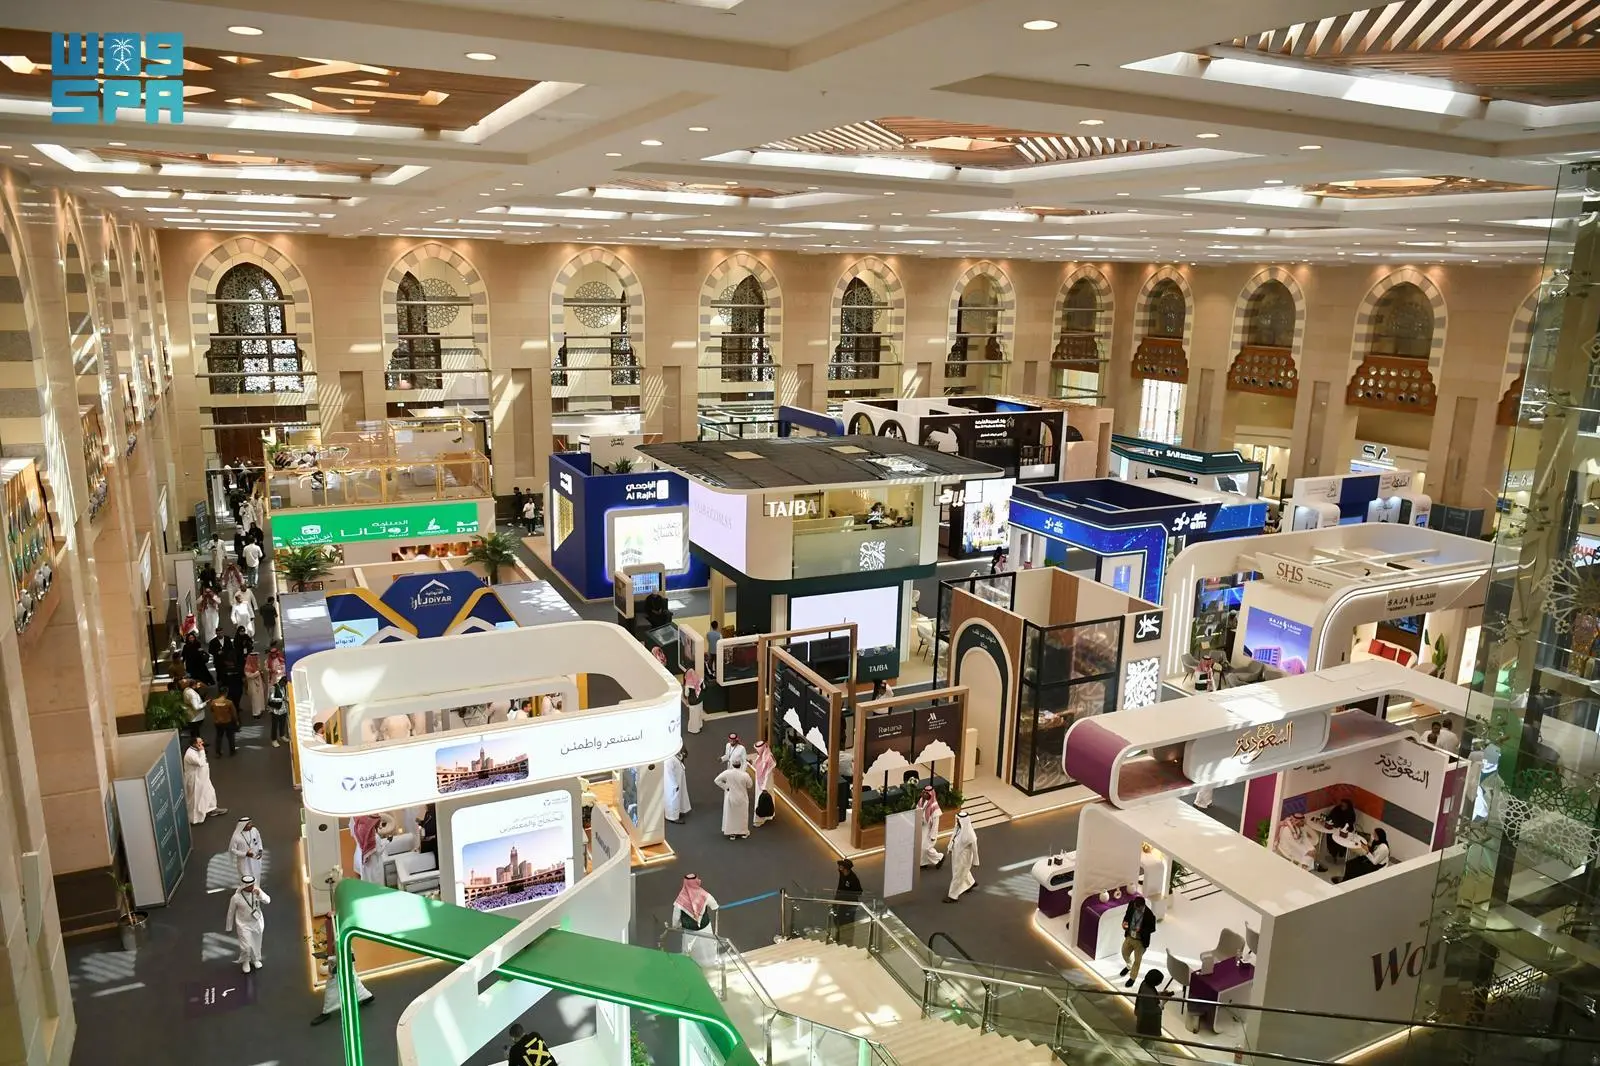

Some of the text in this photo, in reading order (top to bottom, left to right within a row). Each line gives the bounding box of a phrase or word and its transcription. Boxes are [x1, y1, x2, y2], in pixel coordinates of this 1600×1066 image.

[625, 480, 656, 492] الراجحي
[626, 492, 635, 500] Al
[767, 499, 818, 518] TAIBA
[1189, 519, 1207, 530] elm
[1276, 562, 1304, 582] SHS
[1387, 596, 1409, 607] SAJA
[868, 663, 888, 673] TAIBA
[878, 724, 902, 734] Rotana
[560, 730, 643, 757] استشعر واطمئن
[359, 769, 395, 781] التعاونية
[360, 778, 395, 789] tawuniya
